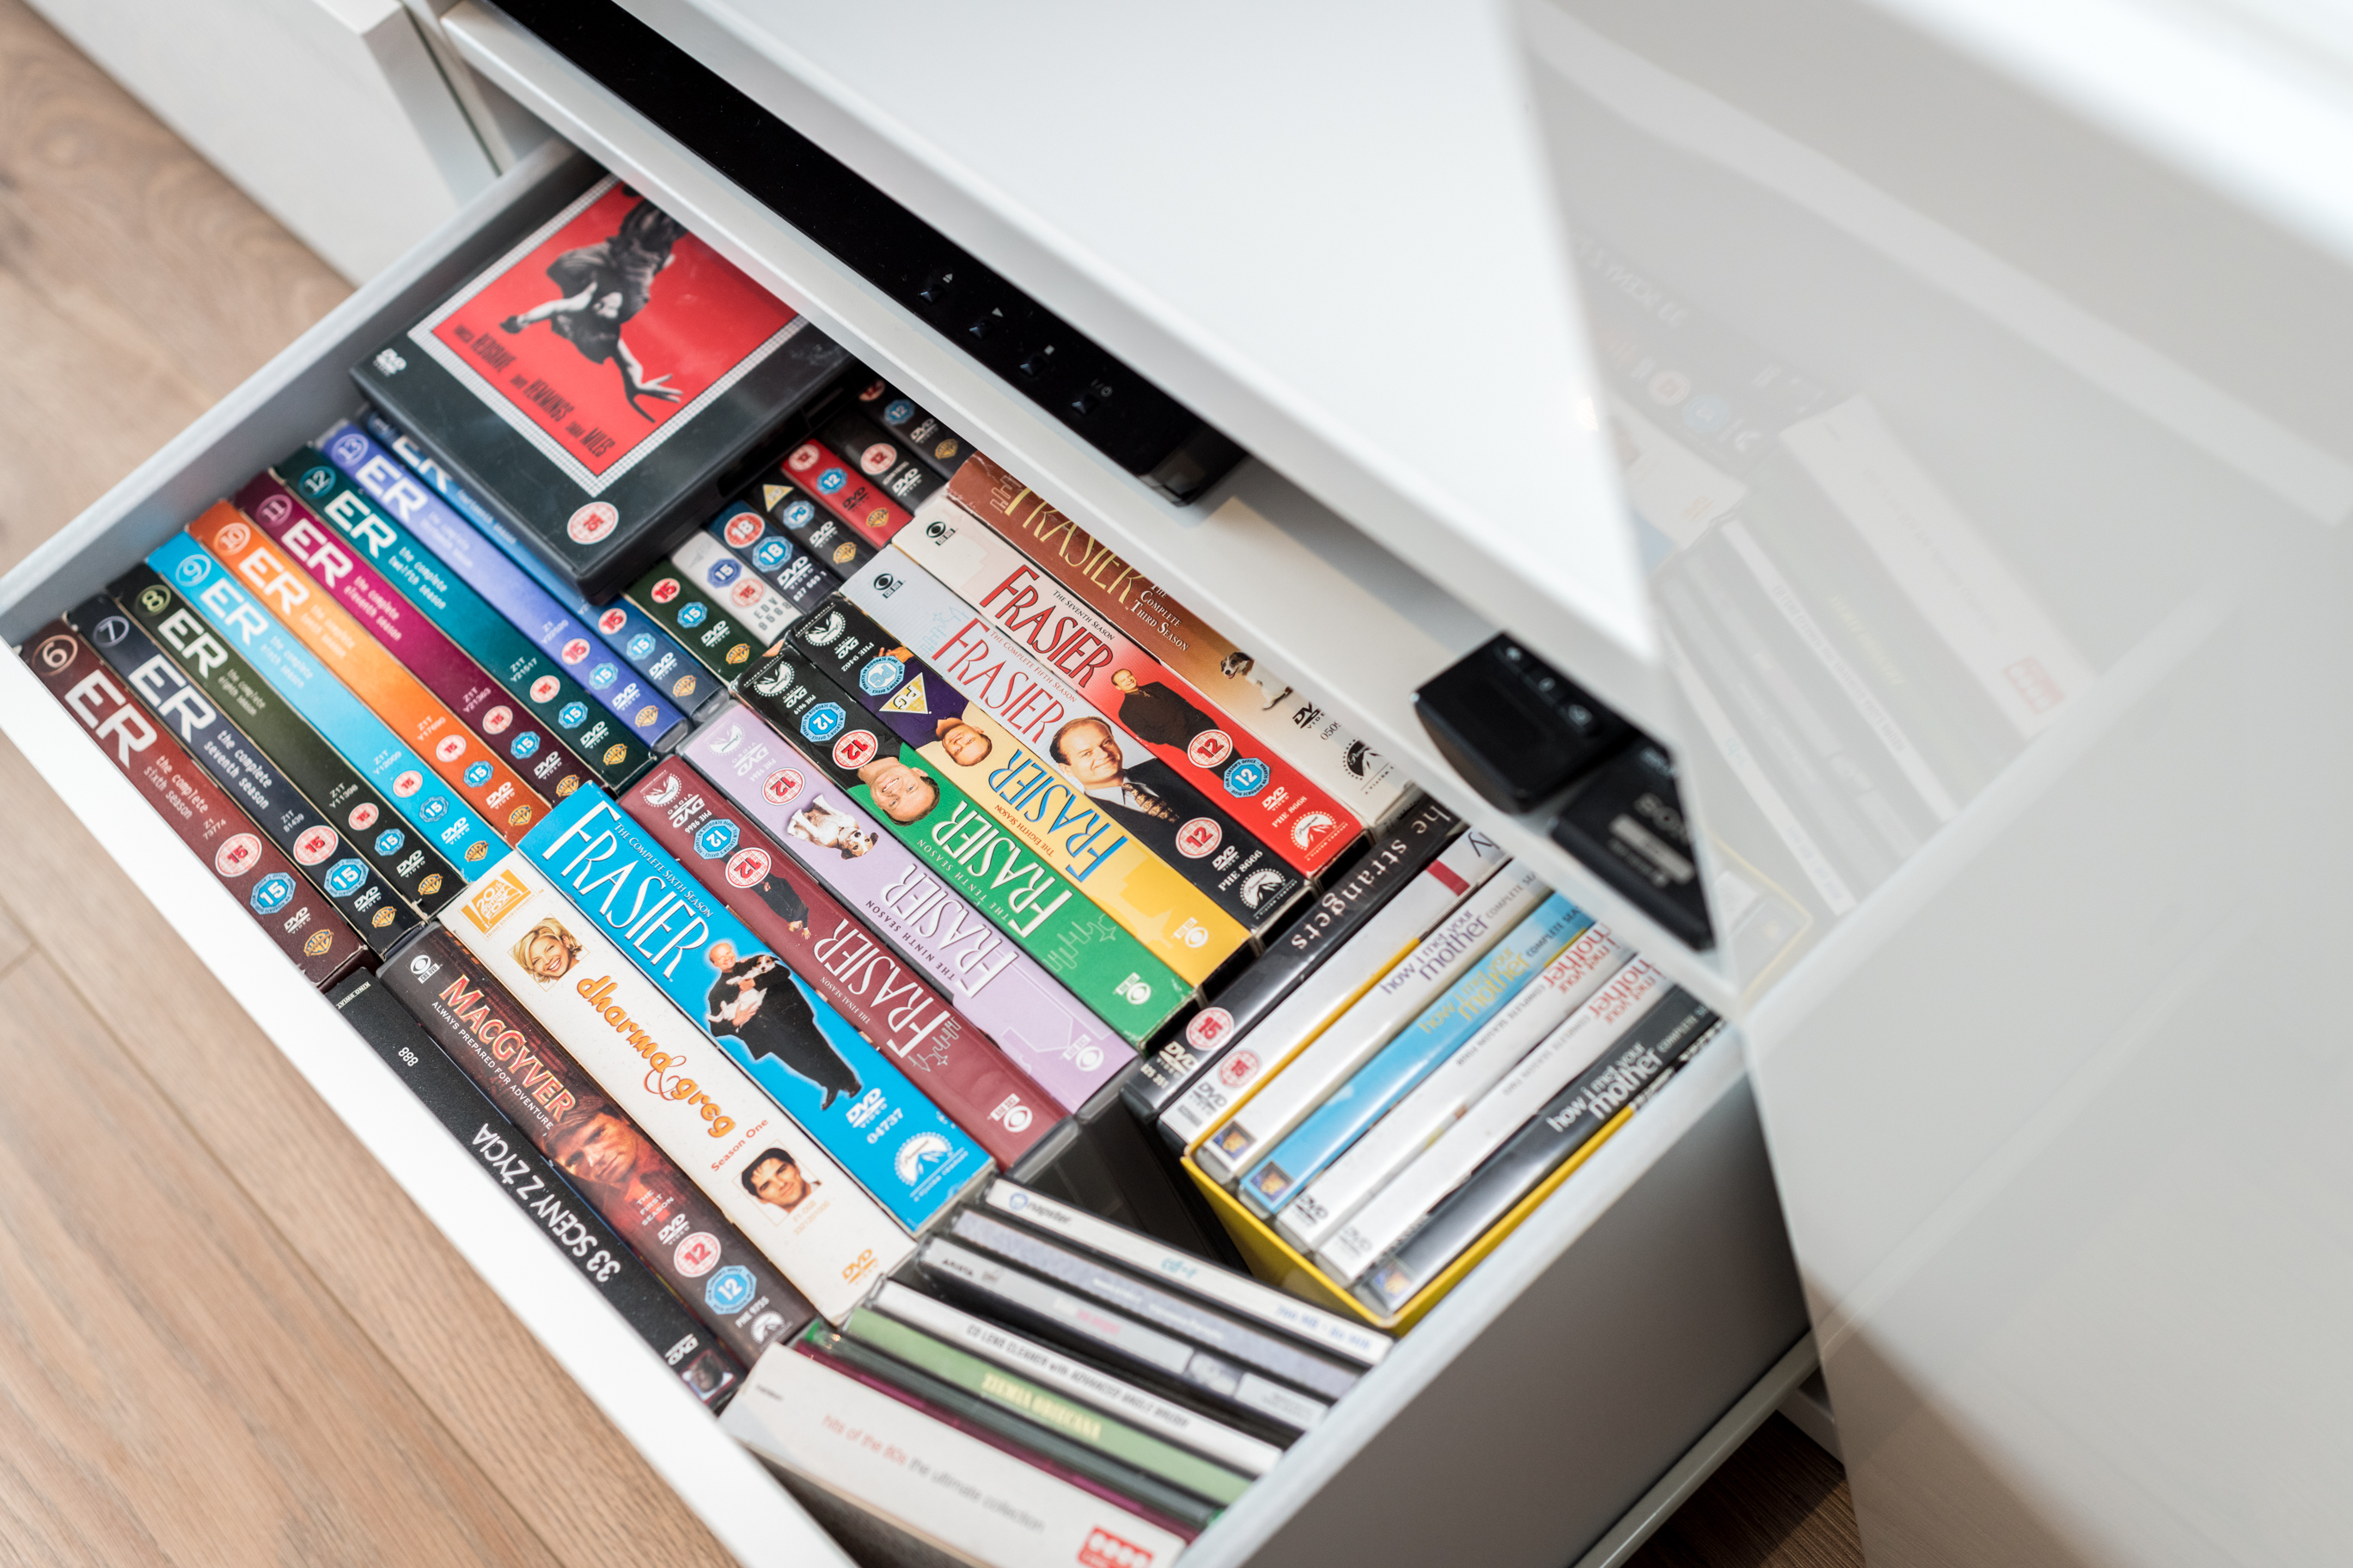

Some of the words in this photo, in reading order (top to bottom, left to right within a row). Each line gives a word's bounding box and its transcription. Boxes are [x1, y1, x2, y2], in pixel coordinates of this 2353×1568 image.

[584, 428, 615, 459] MILES
[305, 471, 327, 492] 12
[356, 455, 429, 523] ER
[826, 474, 840, 488] 12
[220, 529, 243, 549] 10
[325, 490, 397, 558] ER
[731, 519, 755, 538] 18
[281, 518, 353, 589] ER
[761, 541, 784, 561] 18
[184, 560, 202, 581] 9
[239, 546, 309, 615] ER
[388, 557, 419, 586] twelfth
[419, 584, 446, 609] season
[399, 546, 414, 562] the
[413, 557, 448, 593] complete
[716, 566, 734, 579] 15
[777, 557, 809, 589] DVD
[139, 589, 164, 609] 8
[354, 577, 369, 591] the
[368, 586, 400, 621] complete
[657, 583, 675, 599] 15
[200, 577, 268, 645] ER
[344, 585, 376, 619] eleventh
[376, 615, 402, 641] season
[685, 607, 700, 621] 15
[1053, 589, 1068, 603] THE
[1065, 600, 1093, 625] SEVENTH
[1091, 621, 1115, 641] SEASON
[1140, 590, 1183, 627] COMPLETE
[701, 620, 727, 645] DVD
[980, 564, 1113, 688] FRASIER
[1129, 600, 1164, 627] THIRD
[1157, 623, 1189, 651] SEASON
[43, 641, 68, 668] 6
[157, 608, 229, 679] ER
[859, 641, 875, 657] PHE
[841, 653, 860, 672] 9462
[867, 666, 896, 688] PG
[990, 631, 1005, 645] THE
[1004, 641, 1036, 669] COMPLETE
[1033, 665, 1053, 684] FIFTH
[1052, 680, 1077, 704] SEASON
[931, 618, 1064, 744] FRASIER
[129, 654, 216, 743] ER
[892, 685, 915, 710] PG
[64, 669, 156, 768] ER
[565, 708, 581, 723] 15
[812, 712, 834, 732] 12
[217, 729, 235, 748] the
[234, 745, 272, 789] complete
[840, 737, 870, 761] 12
[1197, 737, 1224, 760] 12
[156, 755, 174, 773] the
[172, 770, 208, 813] complete
[205, 741, 240, 779] seventh
[238, 778, 269, 809] season
[471, 766, 486, 782] 15
[773, 775, 798, 797] 12
[1235, 768, 1257, 787] 12
[144, 766, 167, 790] sixth
[164, 788, 193, 820] season
[428, 801, 443, 817] 15
[673, 793, 706, 828] DVD
[697, 809, 712, 825] PHE
[988, 749, 1128, 883] FRASIER
[994, 804, 1018, 827] SEASON
[1272, 813, 1290, 828] PHE
[1287, 796, 1307, 817] 8668
[684, 820, 700, 834] 9866
[706, 829, 729, 849] 12
[1016, 822, 1040, 845] EIGHTH
[1186, 824, 1213, 849] 12
[227, 845, 248, 863] 15
[305, 836, 326, 854] 15
[917, 838, 954, 872] SEASON
[1038, 841, 1054, 857] THE
[1212, 845, 1236, 867] DVD
[333, 867, 358, 889] 15
[614, 821, 632, 839] THE
[629, 838, 664, 874] COMPLETE
[663, 869, 687, 894] SIXTH
[684, 890, 714, 919] SEASON
[734, 857, 763, 880] 12
[932, 800, 1073, 938] FRASIER
[1219, 870, 1241, 891] PHE
[1241, 850, 1263, 872] 8666
[260, 882, 284, 904] 15
[541, 800, 710, 979] FRASIER
[954, 871, 987, 902] TENTH
[1291, 839, 1408, 950] strangers
[284, 906, 309, 930] DVD
[865, 900, 901, 934] SEASON
[989, 901, 1010, 922] THE
[881, 863, 1019, 998] FRASIER
[1525, 919, 1565, 958] COMPLETE
[901, 931, 933, 962] NINTH
[1380, 961, 1416, 997] how
[1445, 909, 1474, 939] your
[1417, 914, 1490, 982] mother
[934, 961, 955, 981] THE
[813, 918, 950, 1059] FRASIER
[820, 977, 846, 1002] SEASON
[1458, 952, 1531, 1022] mother
[841, 996, 860, 1014] FINAL
[857, 1010, 871, 1025] THE
[1418, 1000, 1456, 1035] how
[1198, 1016, 1224, 1040] 15
[397, 1046, 419, 1067] 888
[439, 974, 577, 1122] MACGYVER
[577, 975, 673, 1073] dharma
[670, 1078, 736, 1138] greg
[431, 1001, 460, 1030] ALWAYS
[459, 1029, 496, 1069] PREPARED
[494, 1067, 511, 1086] FOR
[510, 1084, 554, 1131] ADVENTURE
[1231, 1059, 1250, 1075] 15
[1546, 1094, 1586, 1132] how
[1614, 1041, 1647, 1075] your
[1587, 1047, 1664, 1120] mother
[845, 1088, 882, 1125] DVD
[866, 1107, 903, 1144] 04737
[472, 1123, 530, 1185] ŻYCIA
[711, 1138, 746, 1173] Season
[746, 1119, 768, 1139] One
[516, 1174, 545, 1200] Z
[636, 1190, 654, 1205] THE
[639, 1193, 663, 1216] FIRST
[641, 1196, 675, 1227] SEASON
[530, 1193, 598, 1257] SCENY
[586, 1249, 620, 1282] 33
[683, 1242, 712, 1265] 12
[718, 1277, 743, 1301] 12
